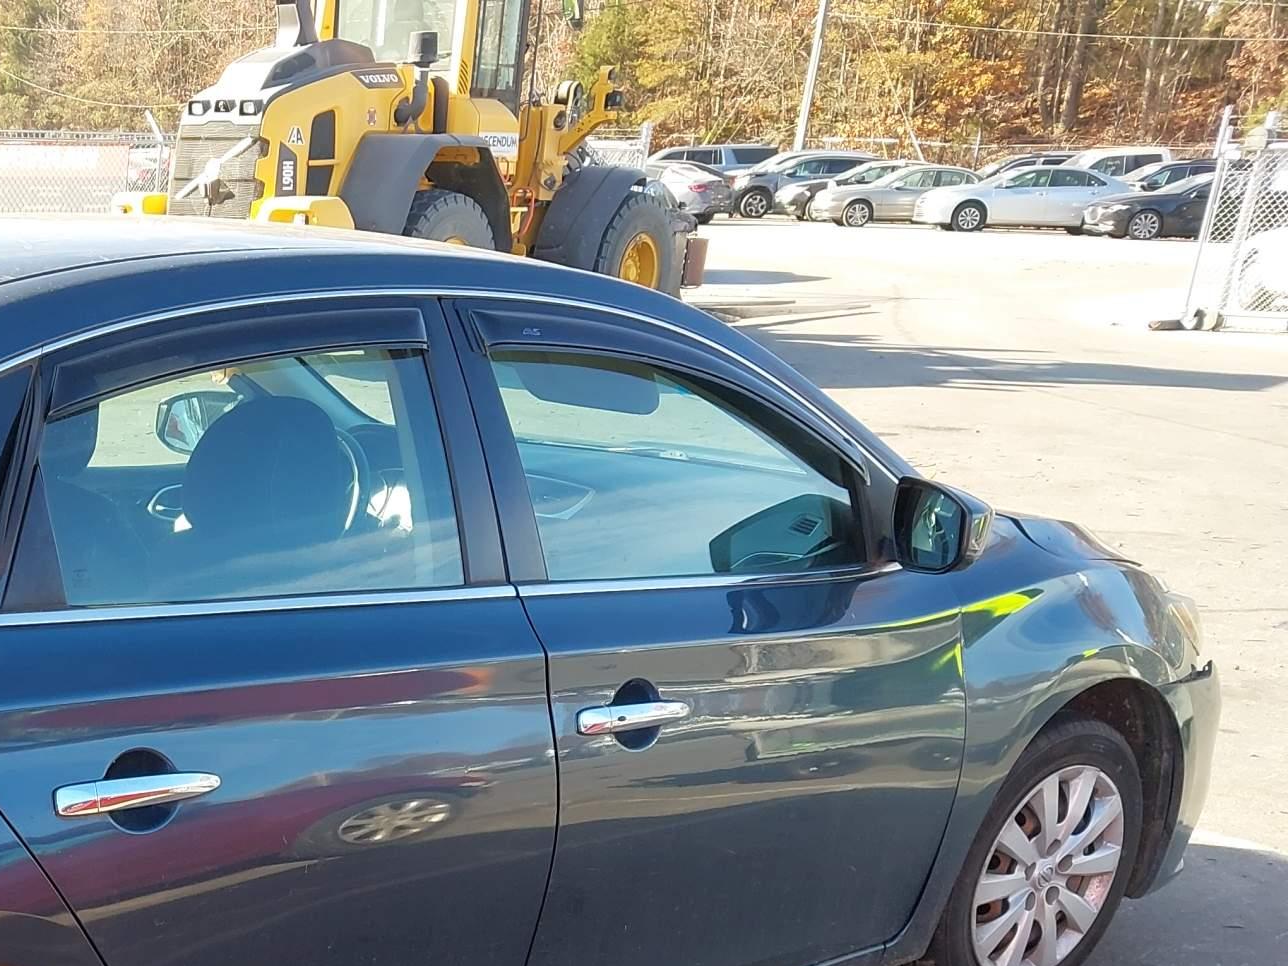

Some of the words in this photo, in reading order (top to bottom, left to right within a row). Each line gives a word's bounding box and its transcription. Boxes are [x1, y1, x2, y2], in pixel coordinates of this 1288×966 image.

[359, 73, 399, 84] VOLVO
[481, 135, 518, 148] SCENDUM
[281, 160, 295, 191] L90H
